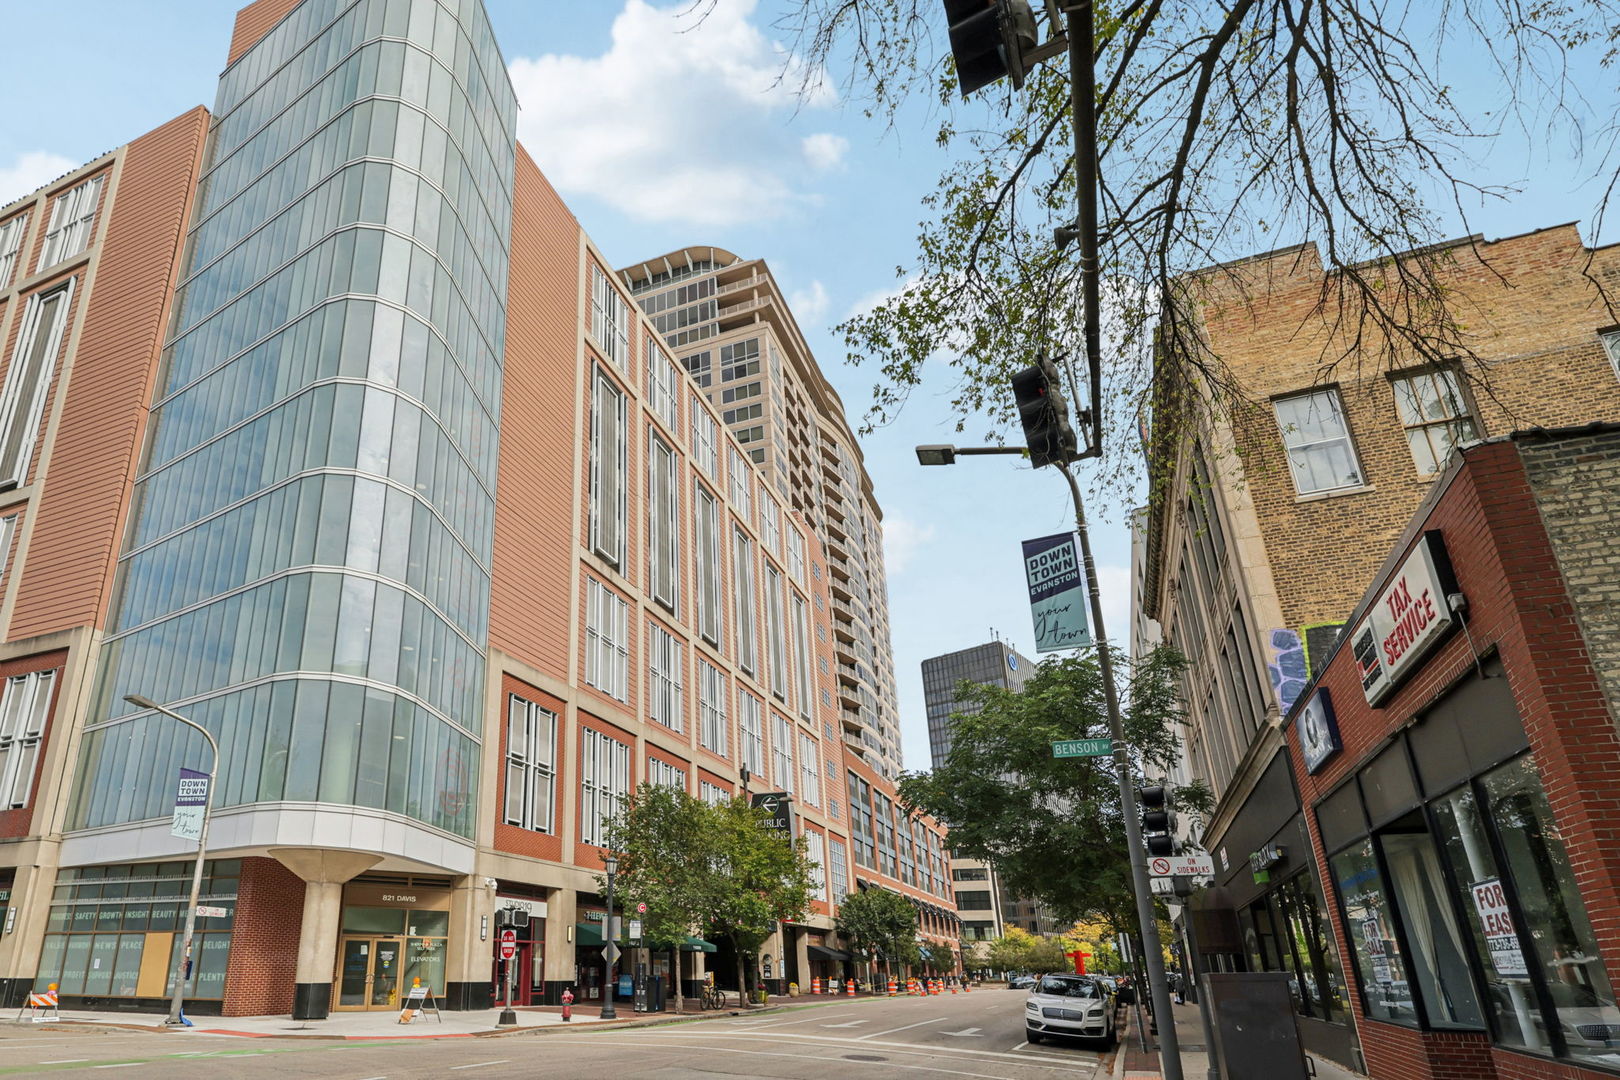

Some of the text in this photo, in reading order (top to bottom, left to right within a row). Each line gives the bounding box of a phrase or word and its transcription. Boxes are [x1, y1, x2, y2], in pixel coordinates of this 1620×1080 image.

[1030, 544, 1072, 571] DOWN
[1031, 557, 1073, 583] TOWN
[1030, 570, 1079, 596] EVANSTON
[1386, 575, 1413, 622] TAX
[1034, 603, 1071, 642] your
[1047, 620, 1087, 643] town
[1383, 588, 1436, 666] SERVICE
[1055, 742, 1099, 755] BENSON
[1176, 866, 1210, 874] SIDEWALKS
[396, 895, 417, 903] DAVIS
[1475, 884, 1507, 910] FOR
[75, 911, 97, 920] SAFETY
[152, 910, 177, 919] BEAUTY
[1480, 912, 1514, 937] LEAS
[200, 972, 226, 982] PLENTY
